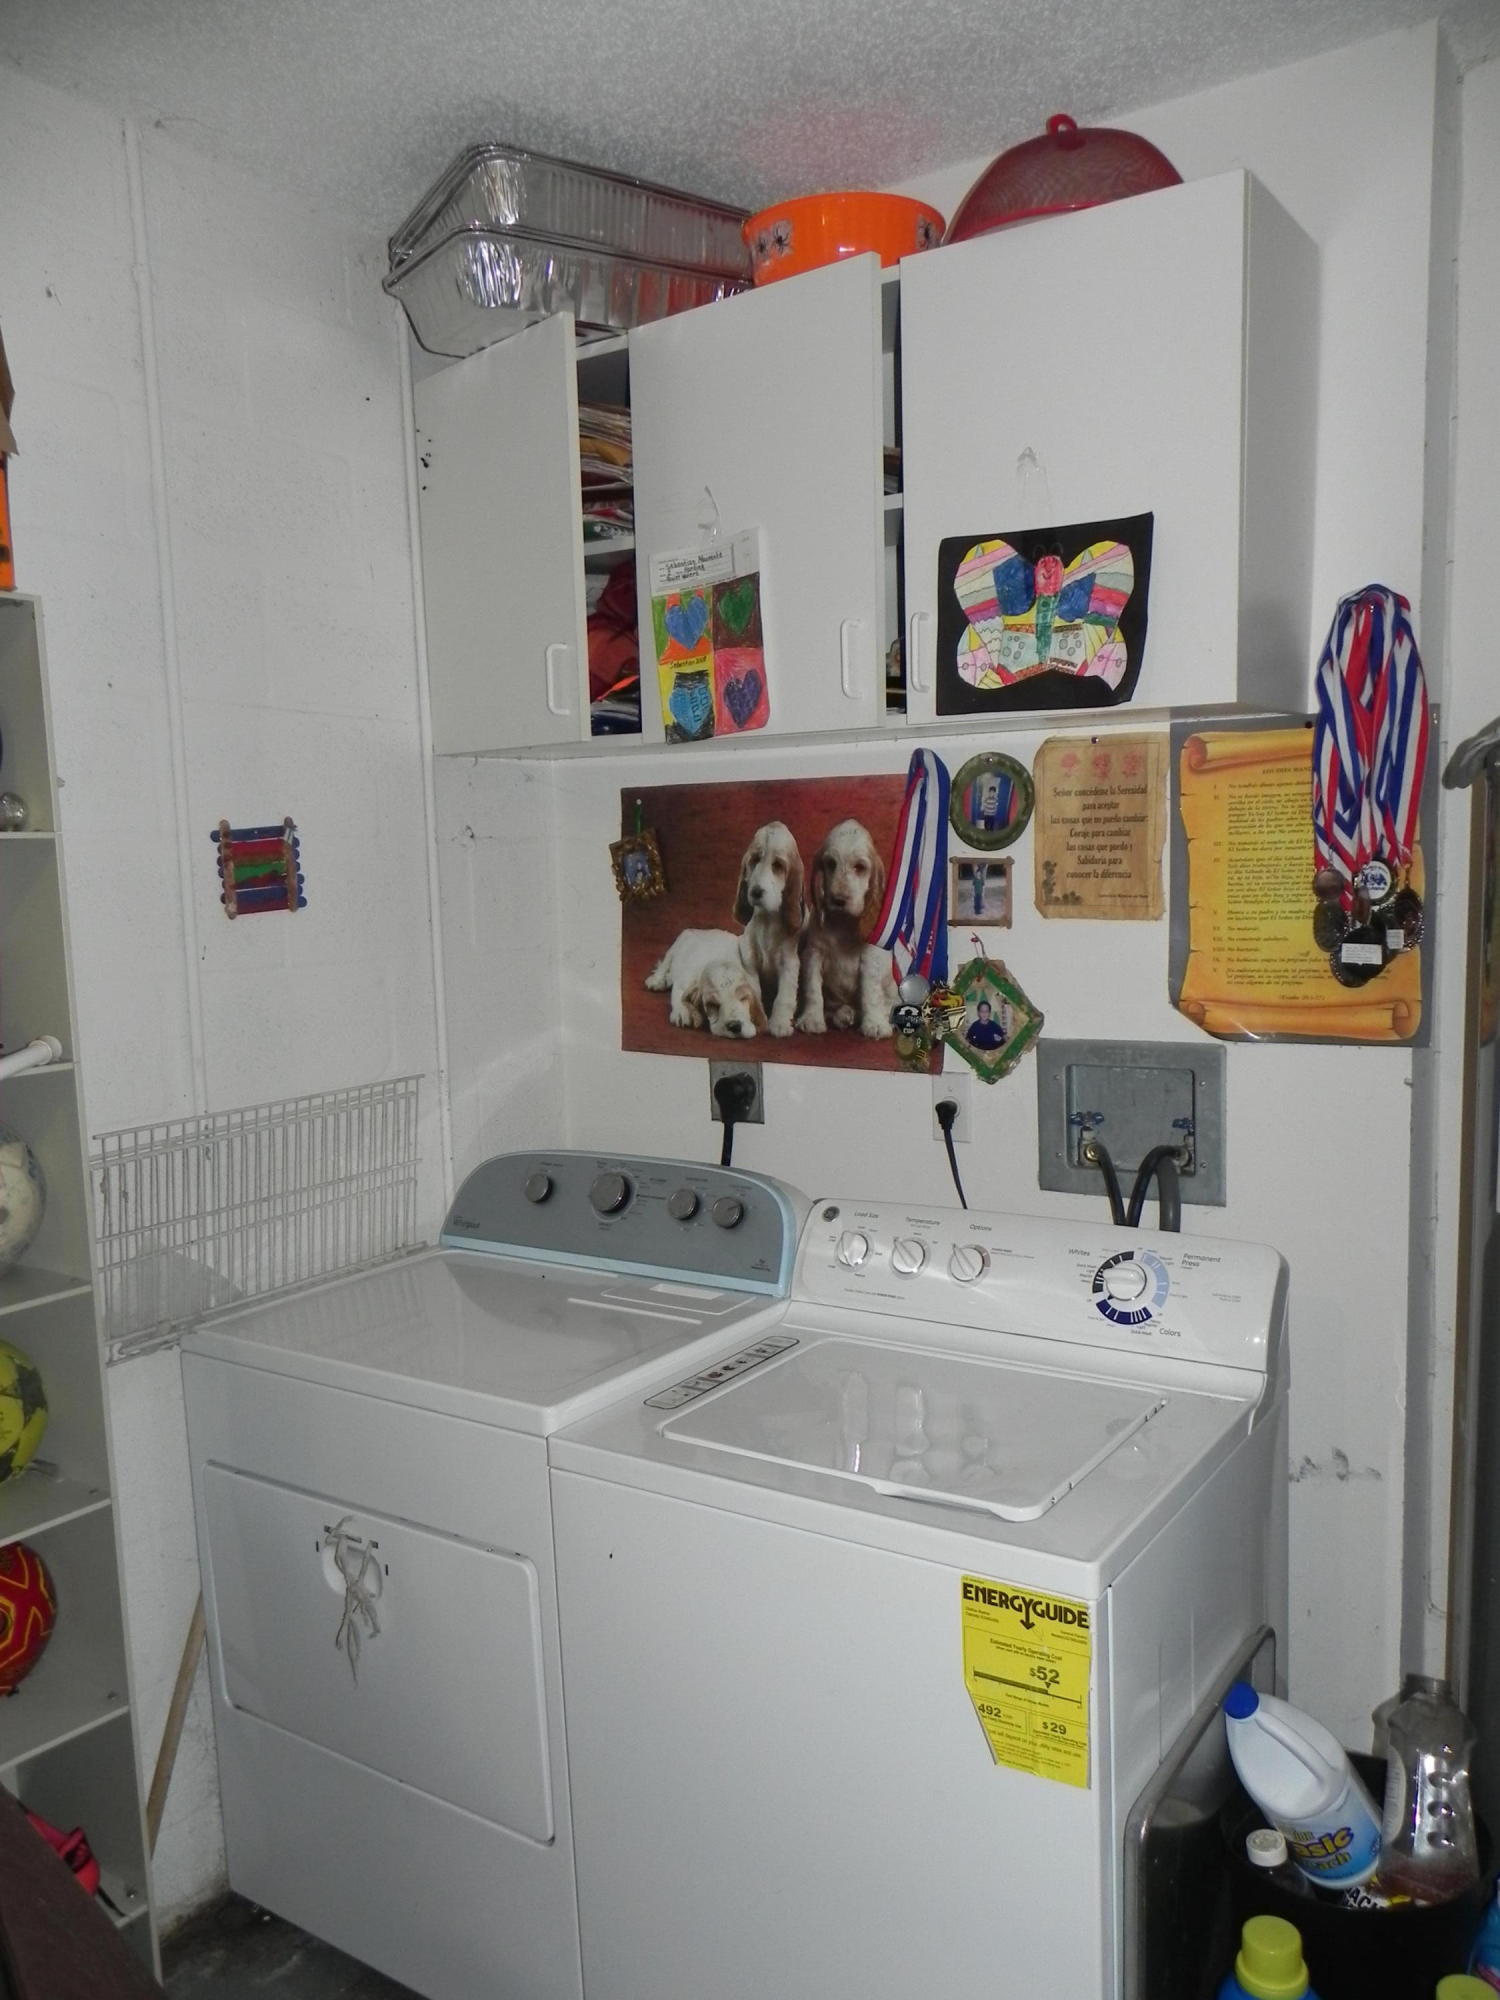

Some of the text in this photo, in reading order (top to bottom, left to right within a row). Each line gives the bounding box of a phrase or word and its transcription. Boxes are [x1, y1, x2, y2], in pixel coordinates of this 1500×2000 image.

[1118, 784, 1148, 795] Serenidad
[1082, 801, 1120, 811] para aceptar
[1081, 817, 1092, 826] que
[1102, 814, 1121, 825] puedo
[1069, 828, 1090, 839] Coraje
[1091, 829, 1106, 839] para
[1096, 844, 1108, 853] que
[1109, 841, 1129, 852] puedo
[1108, 857, 1123, 866] para
[1066, 869, 1132, 880] conocer la diferencia
[905, 1216, 941, 1226] Temperature
[969, 1223, 993, 1232] Options
[1068, 1248, 1091, 1257] Whites
[1183, 1253, 1221, 1264] Permanent
[1159, 1327, 1182, 1338] Colors
[962, 1582, 1090, 1630] ENERGYGUIDE
[1030, 1666, 1060, 1684] $52
[978, 1703, 1002, 1718] 492
[1292, 1827, 1354, 1858] asic
